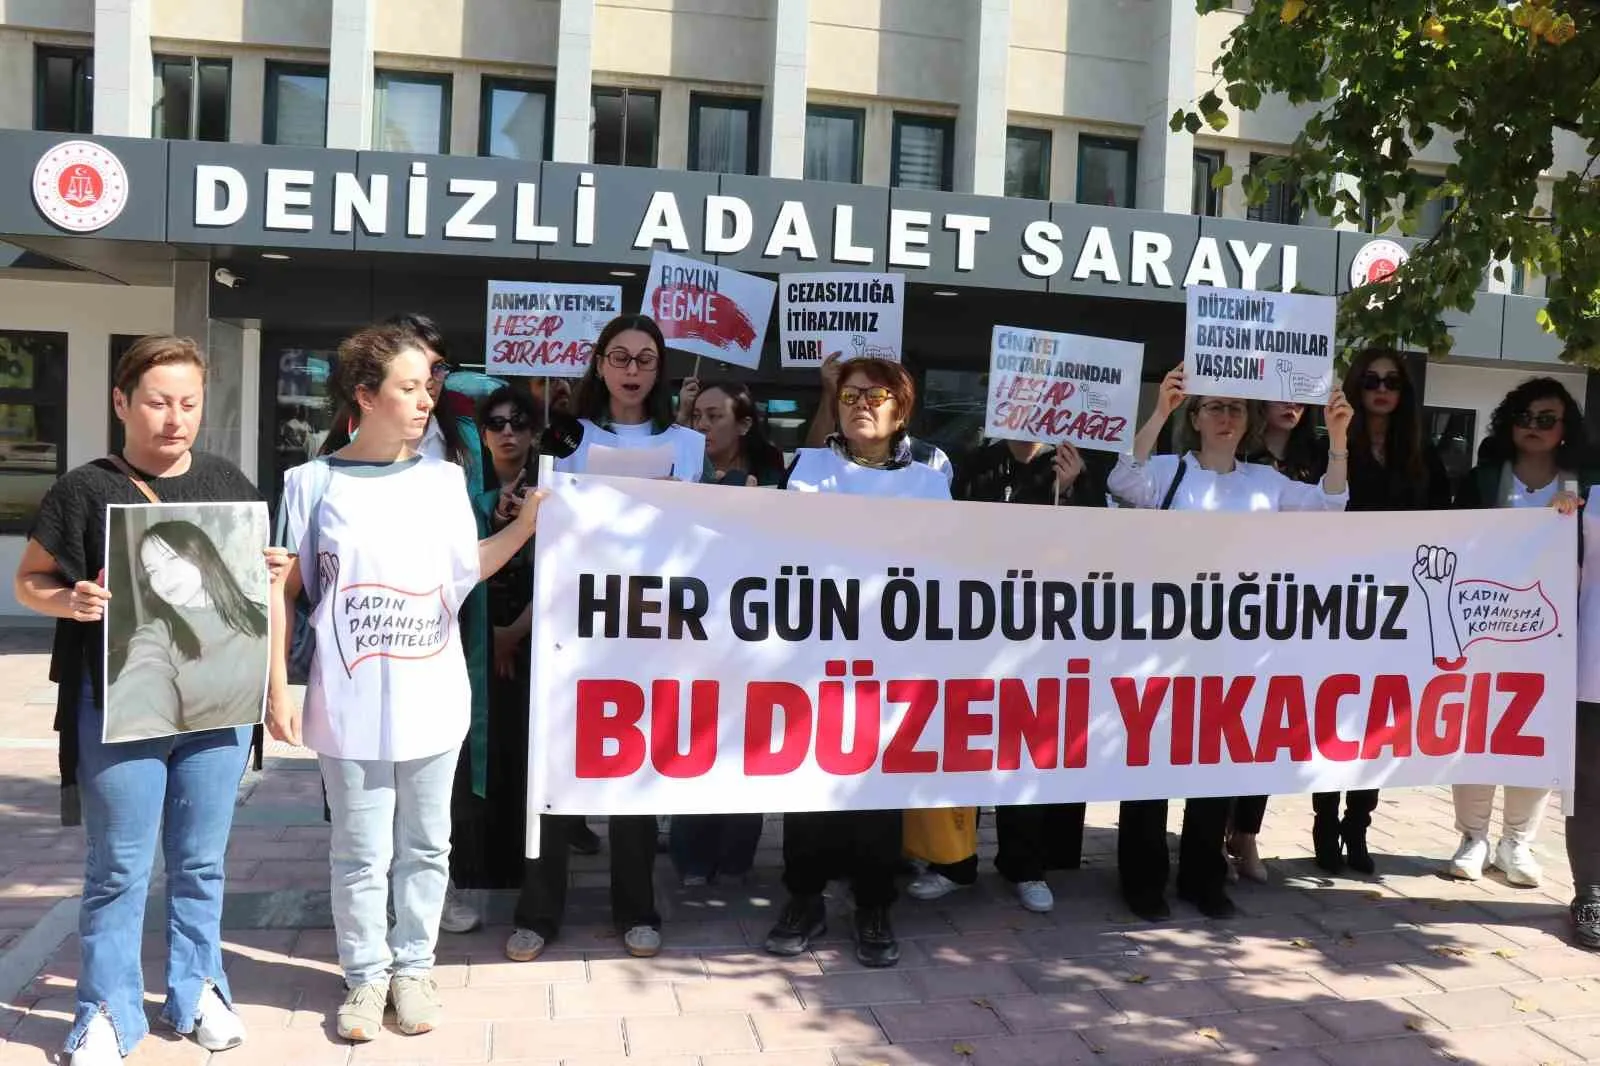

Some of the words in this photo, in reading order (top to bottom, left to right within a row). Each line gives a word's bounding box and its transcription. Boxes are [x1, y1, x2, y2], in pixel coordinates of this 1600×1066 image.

[194, 162, 596, 245] DENİZLİ
[633, 191, 991, 271] ADALET
[1020, 220, 1297, 293] SARAYI
[660, 265, 719, 293] BOYUN
[787, 279, 895, 304] CEZASIZLIĞA
[491, 293, 551, 311] ANMAK
[554, 294, 616, 312] YETMEZ
[1197, 295, 1275, 324] DÜZENİNİZ
[493, 314, 565, 338] HESAP
[787, 308, 879, 333] İTİRAZIMIZ
[492, 339, 594, 368] SORACAĞ
[787, 340, 823, 360] VAR!
[998, 331, 1060, 356] CİNAYET
[1196, 324, 1250, 351] BATSIN
[1254, 329, 1328, 357] KADINLAR
[996, 354, 1122, 385] ORTAKLARINDAN
[1195, 352, 1265, 383] YAŞASIN!
[995, 375, 1076, 408] HESAP
[992, 401, 1128, 442] SORACAĞIZ
[345, 596, 406, 615] KADIN
[578, 573, 710, 642] HER
[729, 565, 861, 642] GÜN
[880, 567, 1409, 642] ÖLDÜRÜLDÜĞÜMÜZ
[1459, 590, 1509, 604] KADIN
[1463, 604, 1542, 621] DAYANIŞMA
[575, 678, 720, 779] BU
[743, 658, 1091, 776] DÜZENİ
[1110, 656, 1546, 767] YIKACAĞIZ
